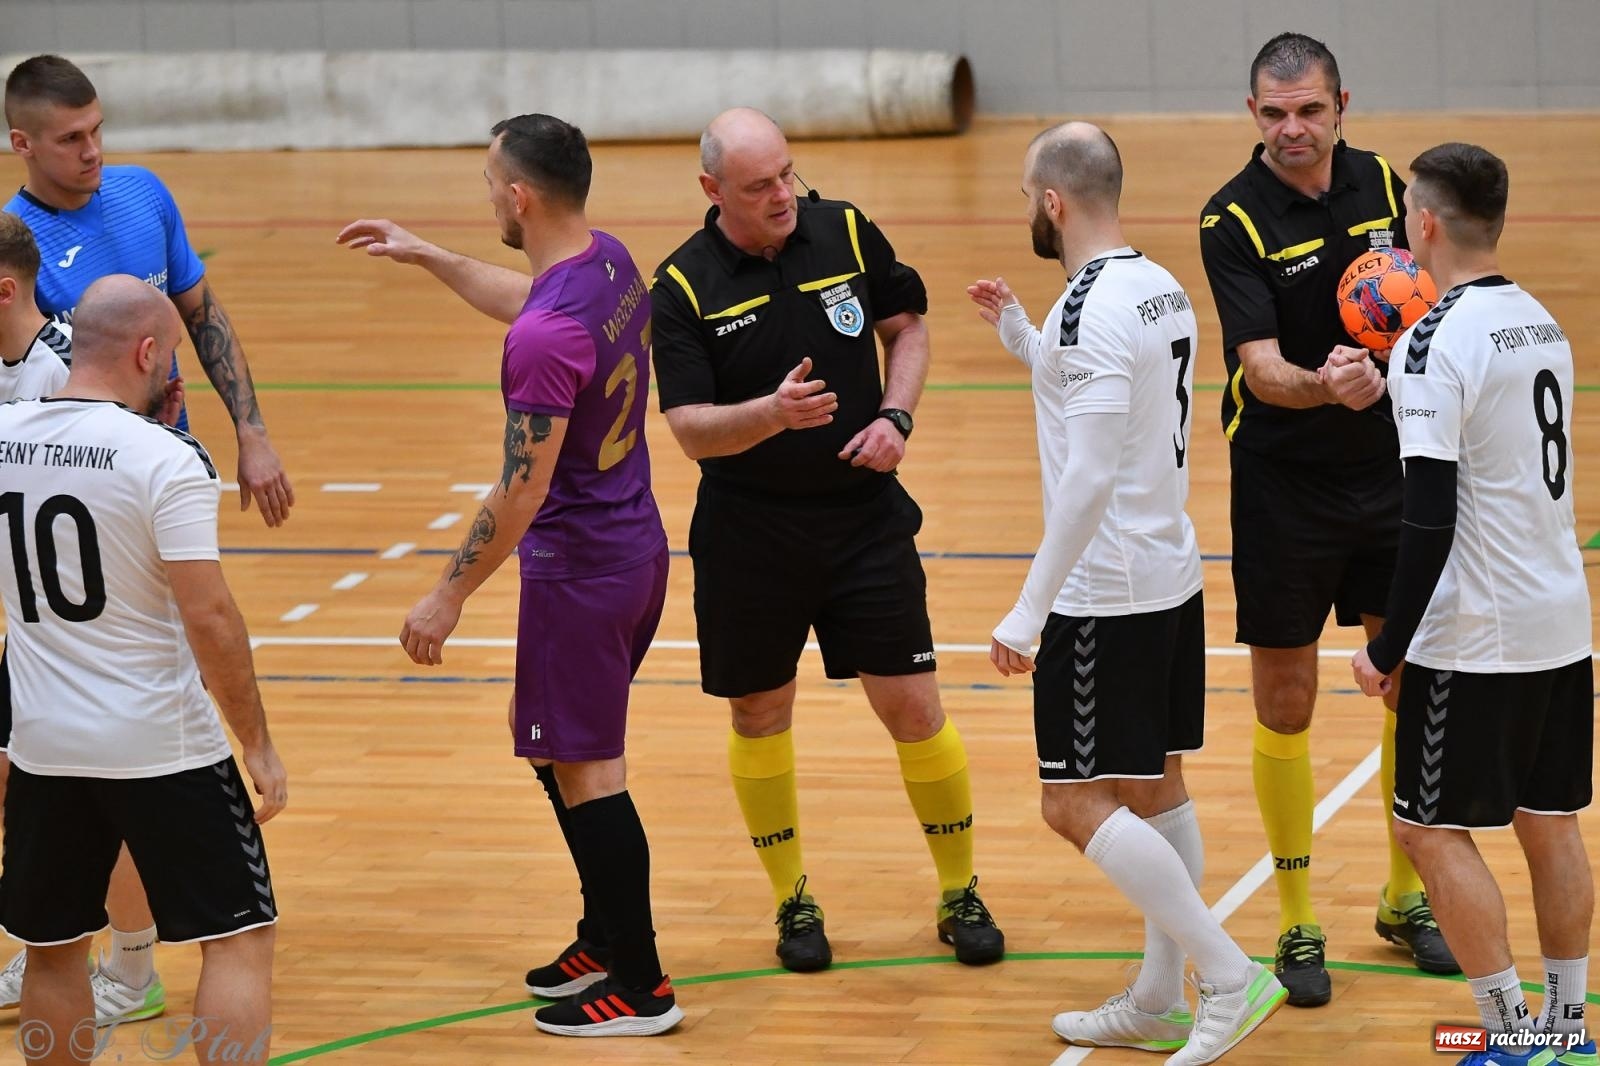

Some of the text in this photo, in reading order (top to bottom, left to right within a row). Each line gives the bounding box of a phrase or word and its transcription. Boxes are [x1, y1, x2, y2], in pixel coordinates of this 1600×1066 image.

[1340, 257, 1382, 293] SELECT
[602, 274, 646, 344] WOŹNIA
[715, 313, 757, 337] zina
[1068, 372, 1095, 382] SPORT
[1171, 336, 1191, 469] 3
[1405, 408, 1438, 419] SPORT
[1533, 368, 1567, 501] 8
[44, 444, 119, 471] TRAWNIK
[0, 491, 107, 623] 10
